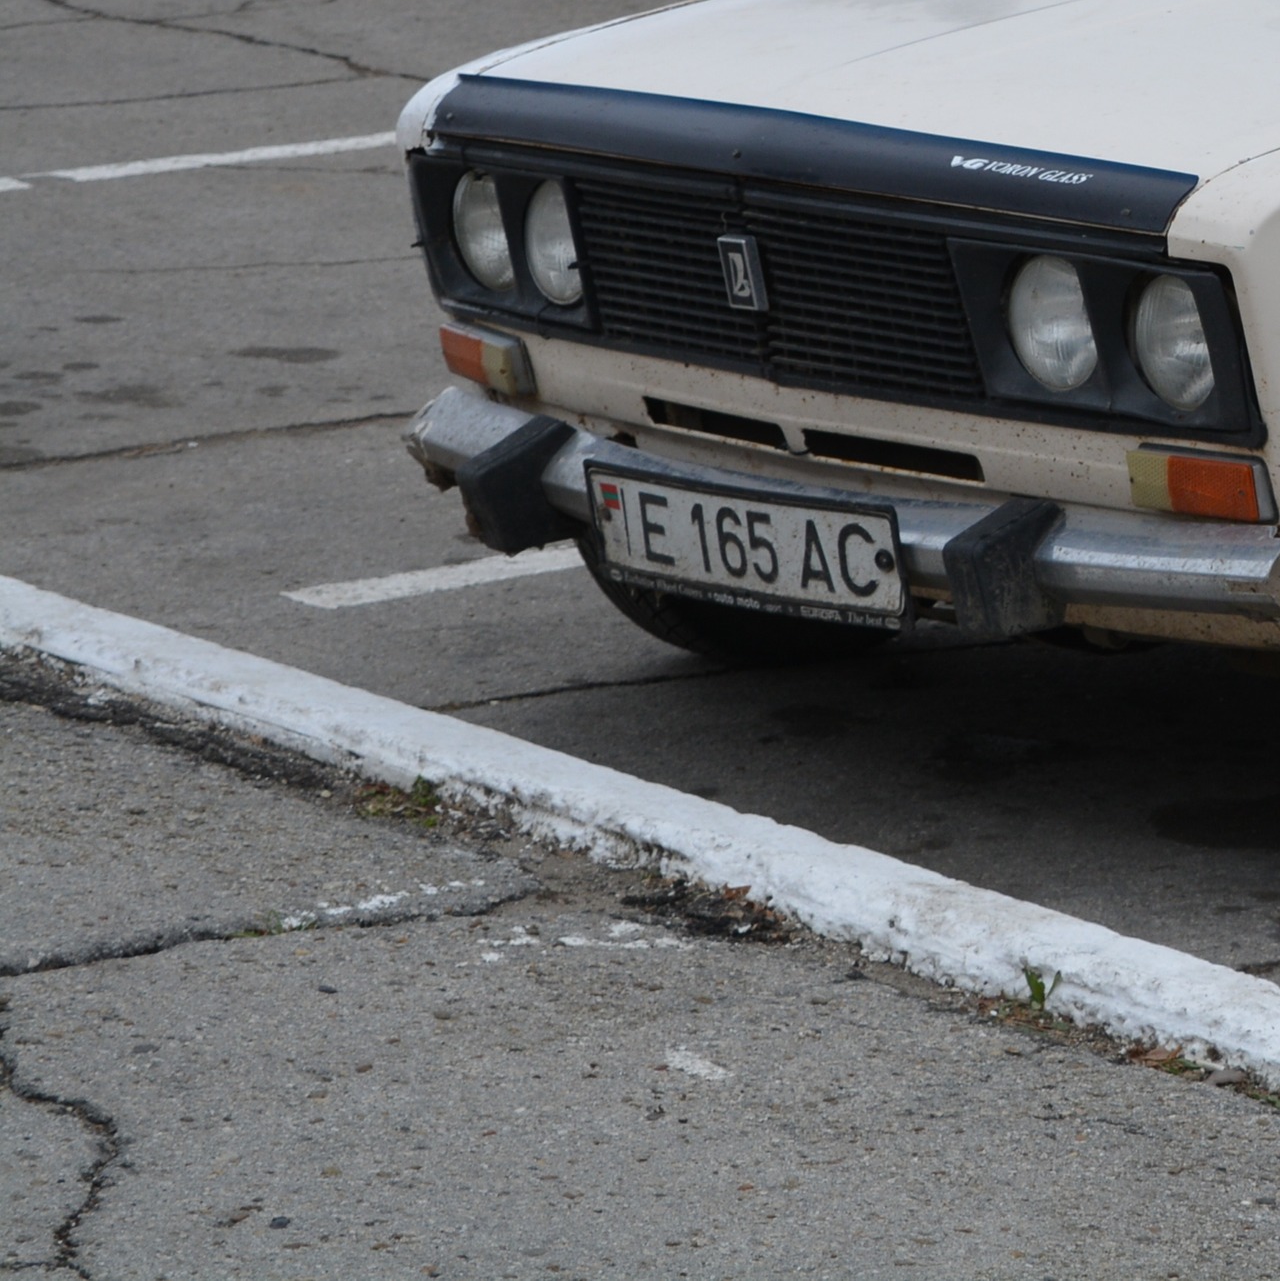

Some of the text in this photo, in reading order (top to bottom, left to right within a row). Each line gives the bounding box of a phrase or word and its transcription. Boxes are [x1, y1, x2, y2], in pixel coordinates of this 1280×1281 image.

[1038, 170, 1093, 184] GLASS
[638, 491, 879, 598] E 165 AC
